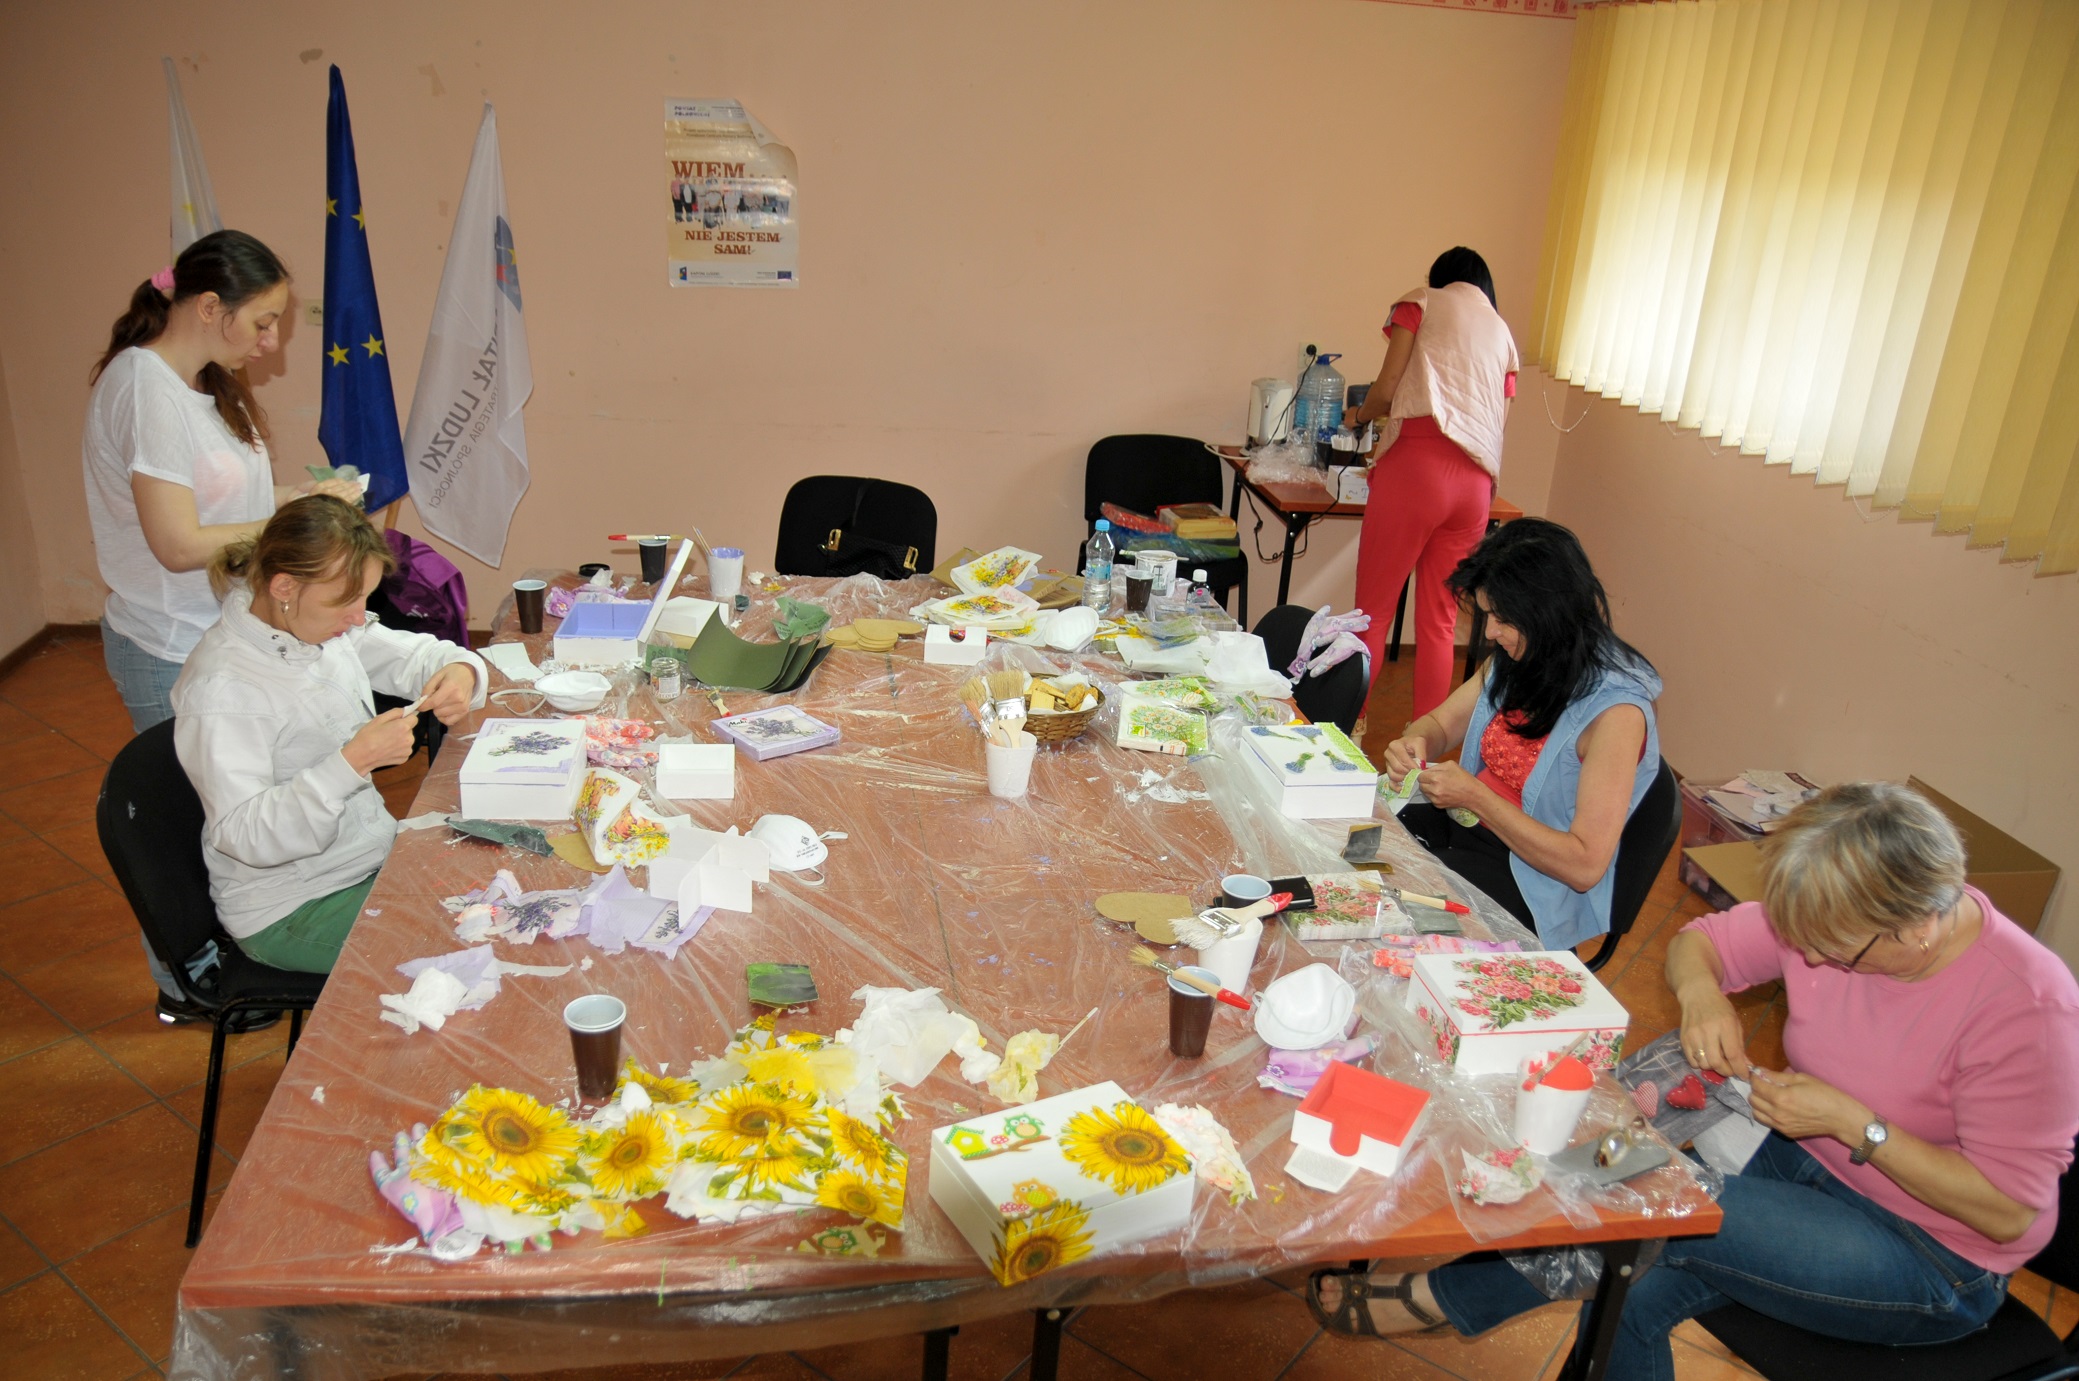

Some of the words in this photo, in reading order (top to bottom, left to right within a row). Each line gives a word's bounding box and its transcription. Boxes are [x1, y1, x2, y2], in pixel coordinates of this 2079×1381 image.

[684, 230, 712, 241] NIE
[717, 231, 780, 243] JESTEM
[714, 243, 751, 255] SAM!
